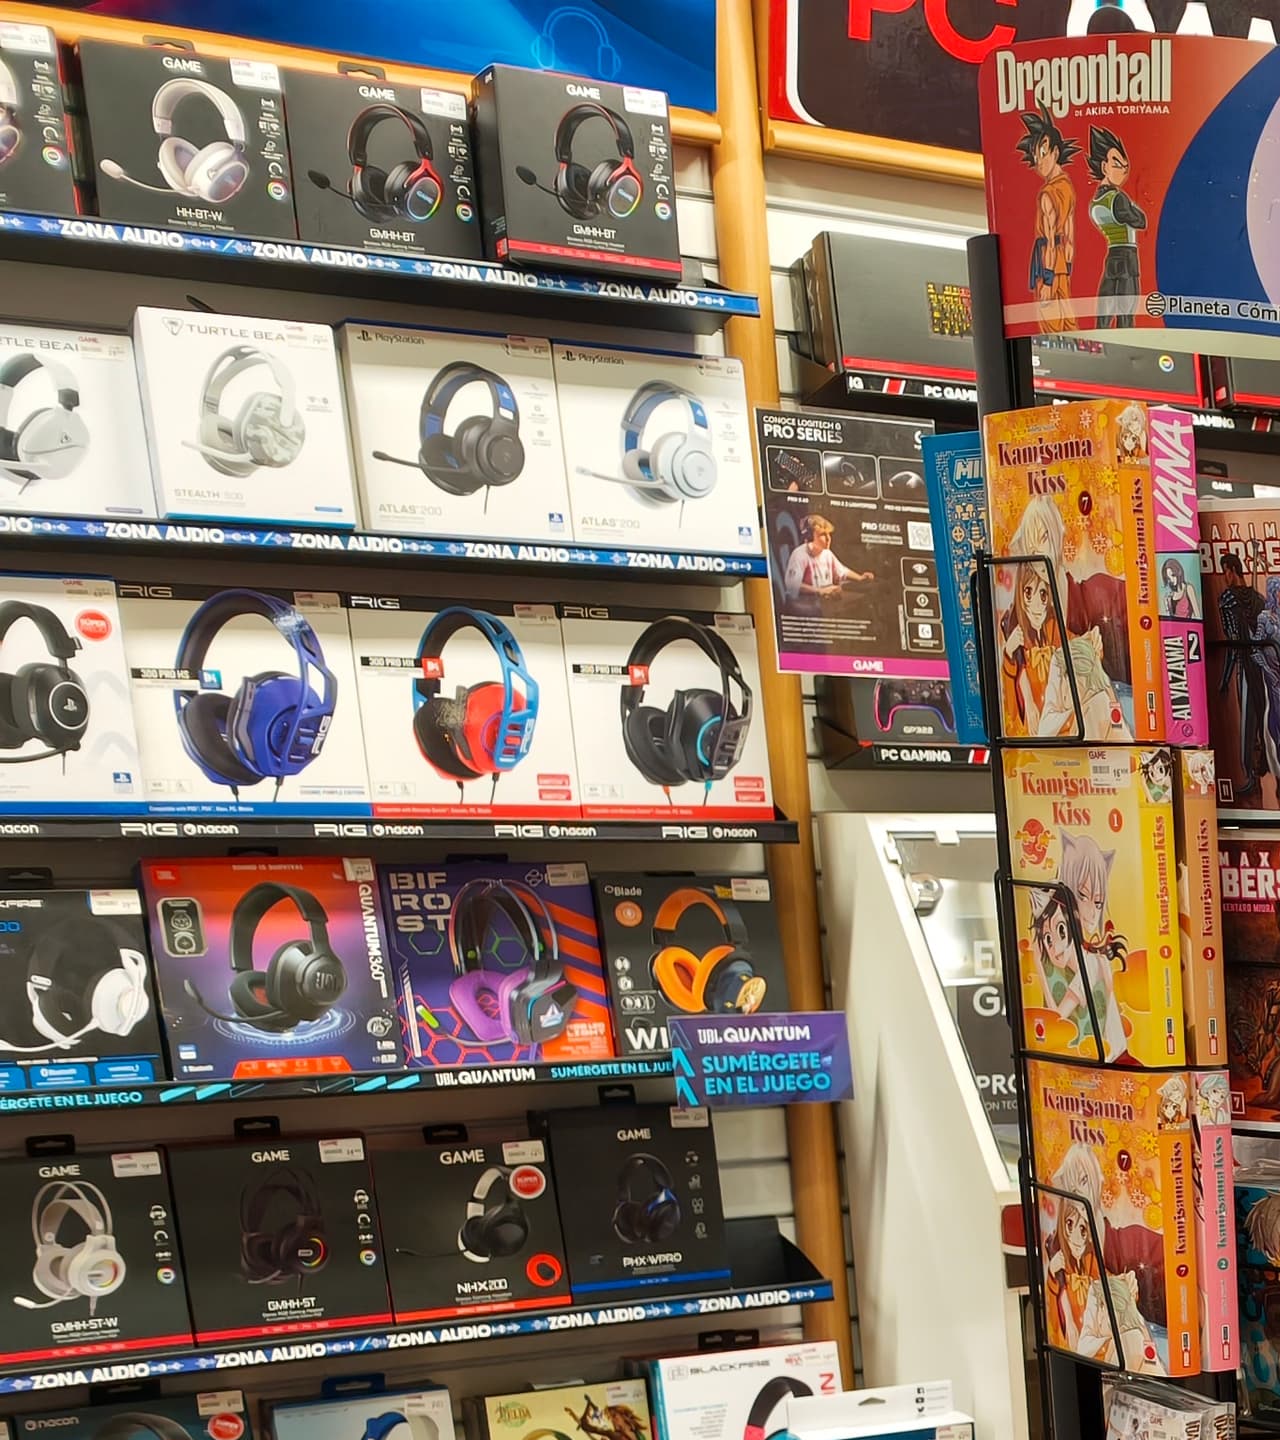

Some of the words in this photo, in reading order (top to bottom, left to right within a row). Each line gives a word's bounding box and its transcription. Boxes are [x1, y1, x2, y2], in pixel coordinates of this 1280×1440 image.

[996, 40, 1172, 118] Dragonball
[58, 219, 118, 239] ZONA
[121, 227, 185, 248] AUDIO
[252, 244, 307, 261] ZONA
[311, 250, 369, 268] AUDIO
[431, 263, 482, 280] ZONA
[486, 269, 539, 287] AUDIO
[1168, 296, 1230, 319] Planeta
[187, 323, 250, 338] TURTLE
[374, 332, 425, 346] PlayStation
[578, 351, 624, 365] PlayStation
[763, 424, 794, 440] PRO
[797, 429, 843, 443] SERIES
[998, 438, 1093, 467] Kamisama
[1027, 469, 1067, 496] Kiss
[1151, 418, 1198, 549] NANA
[120, 585, 172, 598] RIG
[564, 607, 608, 618] RIG
[1053, 802, 1091, 826] Kiss
[121, 823, 179, 836] RIG
[197, 824, 239, 835] nacon
[495, 825, 544, 838] RIG
[560, 826, 596, 836] nacon
[614, 885, 642, 897] Blade
[703, 1052, 821, 1073] SUMÉRGETE
[705, 1078, 726, 1094] EN
[732, 1077, 751, 1093] EL
[755, 1073, 830, 1092] JUEGO
[1043, 1087, 1135, 1121] Kamisama
